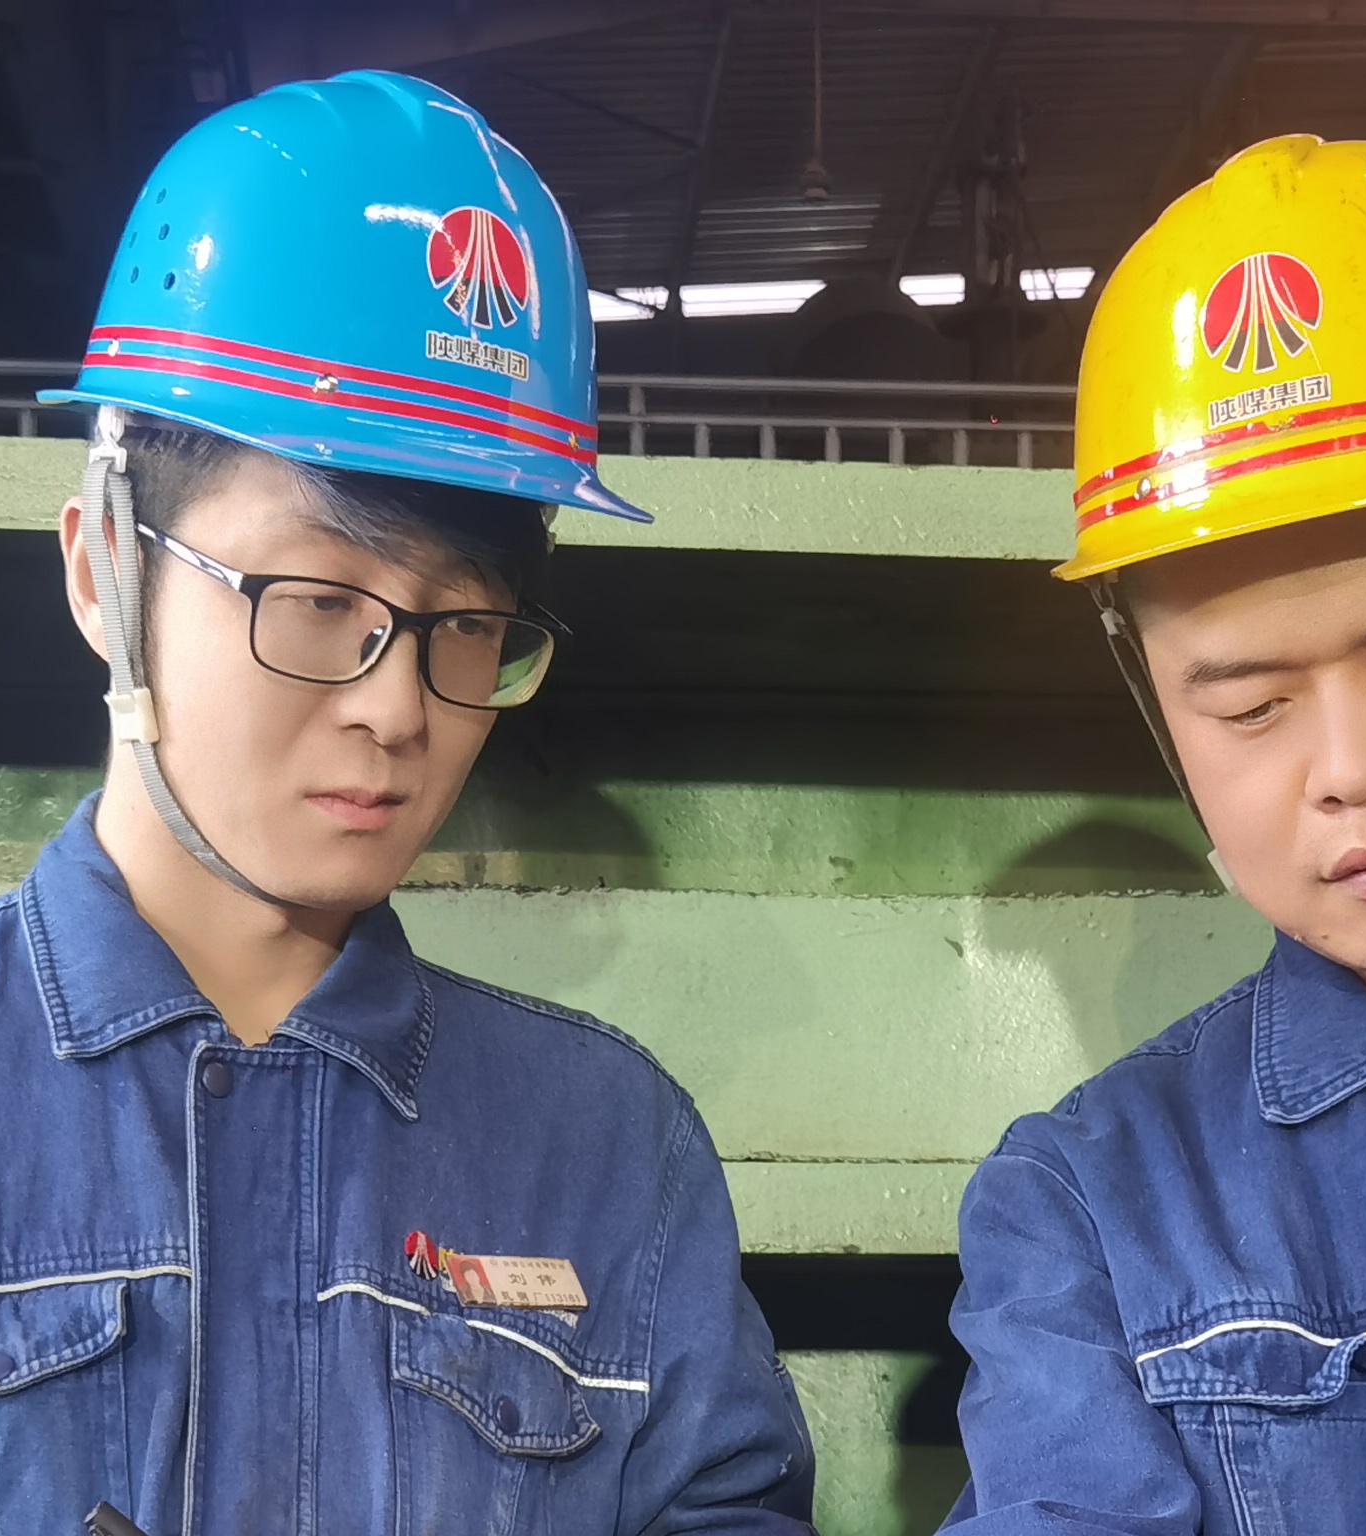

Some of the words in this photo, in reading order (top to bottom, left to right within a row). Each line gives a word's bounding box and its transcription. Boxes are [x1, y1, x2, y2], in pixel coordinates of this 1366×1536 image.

[427, 331, 529, 380] 陕煤集团
[1209, 374, 1330, 427] 陕煤集团
